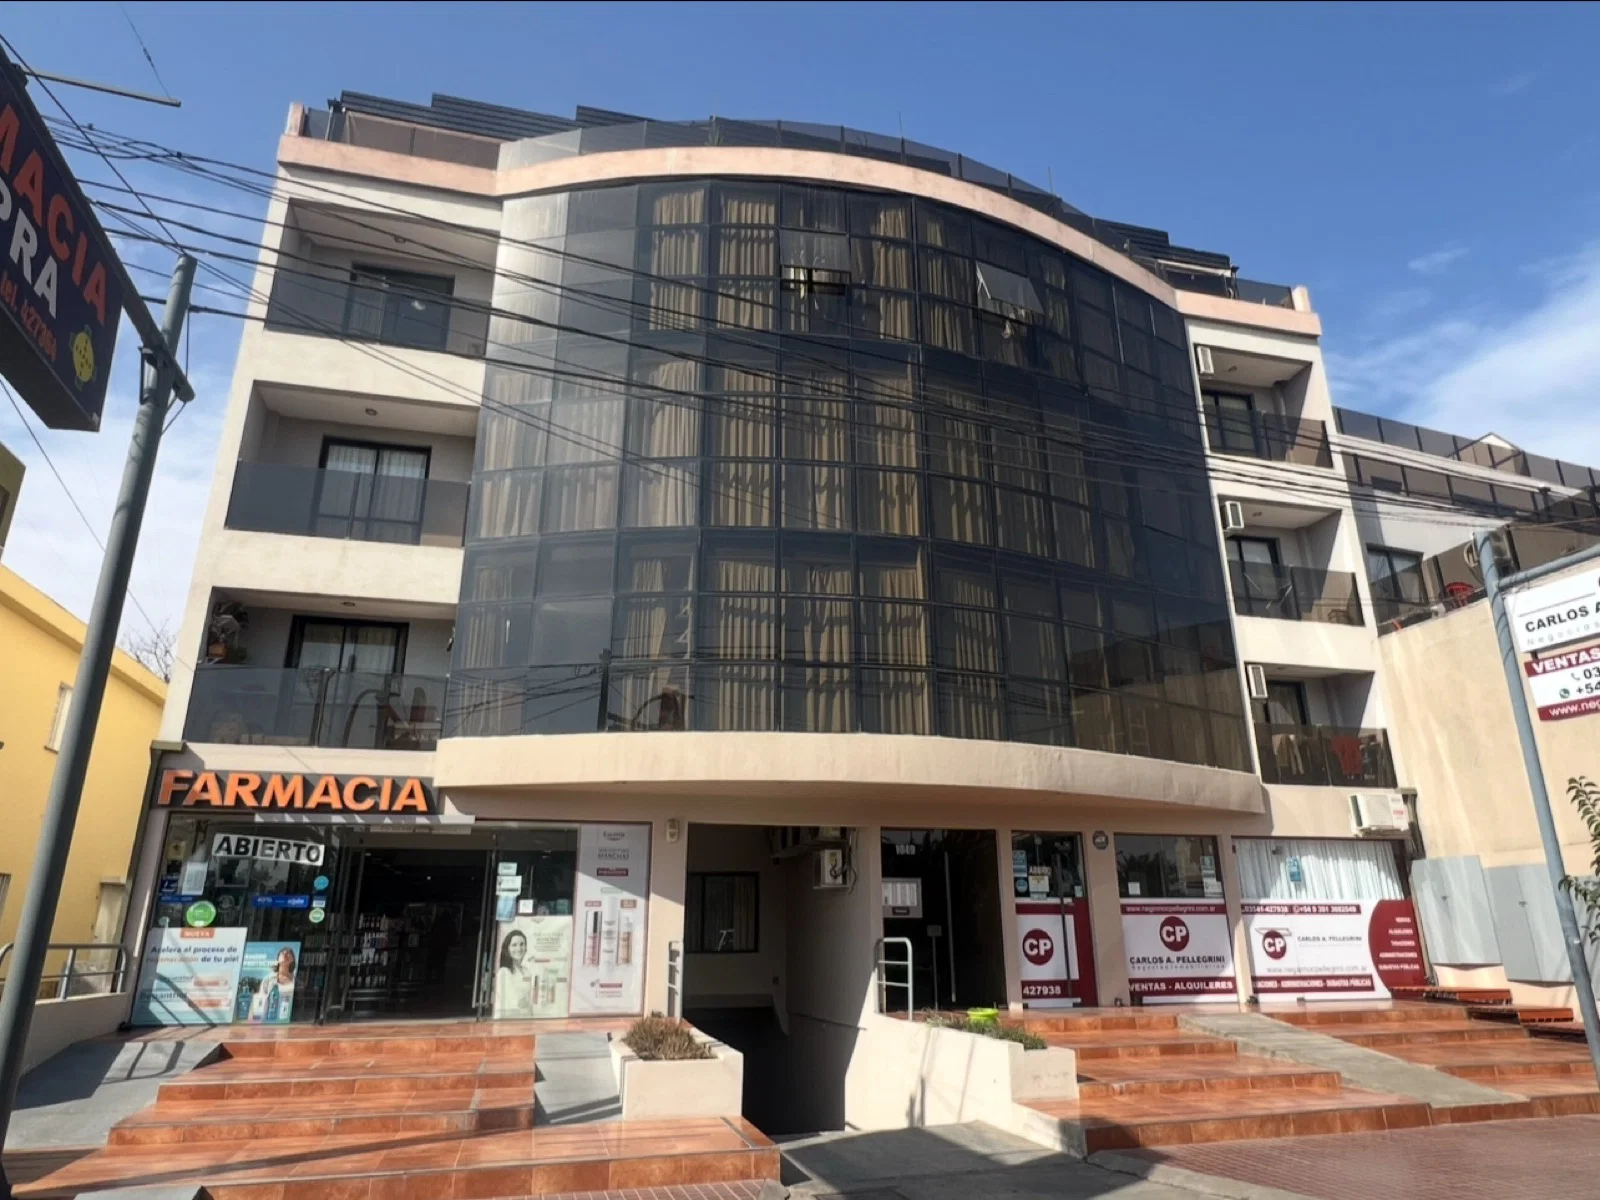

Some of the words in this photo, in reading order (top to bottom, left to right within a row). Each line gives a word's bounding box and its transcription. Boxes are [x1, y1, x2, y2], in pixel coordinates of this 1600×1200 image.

[1525, 605, 1590, 633] CARLOS
[1532, 646, 1600, 674] VENTAS
[157, 769, 428, 812] FARMACIA
[214, 835, 322, 863] ABIERTO
[1162, 926, 1187, 942] CP
[193, 946, 225, 955] proceso
[1024, 938, 1051, 956] CP
[1264, 937, 1284, 952] CP
[201, 955, 211, 963] de
[213, 955, 222, 963] tu
[223, 955, 239, 964] piel
[1130, 956, 1164, 964] CARLOS
[1176, 955, 1225, 963] PELLEGRINI
[1023, 985, 1061, 995] 427938
[1174, 981, 1233, 990] ALQUILERES
